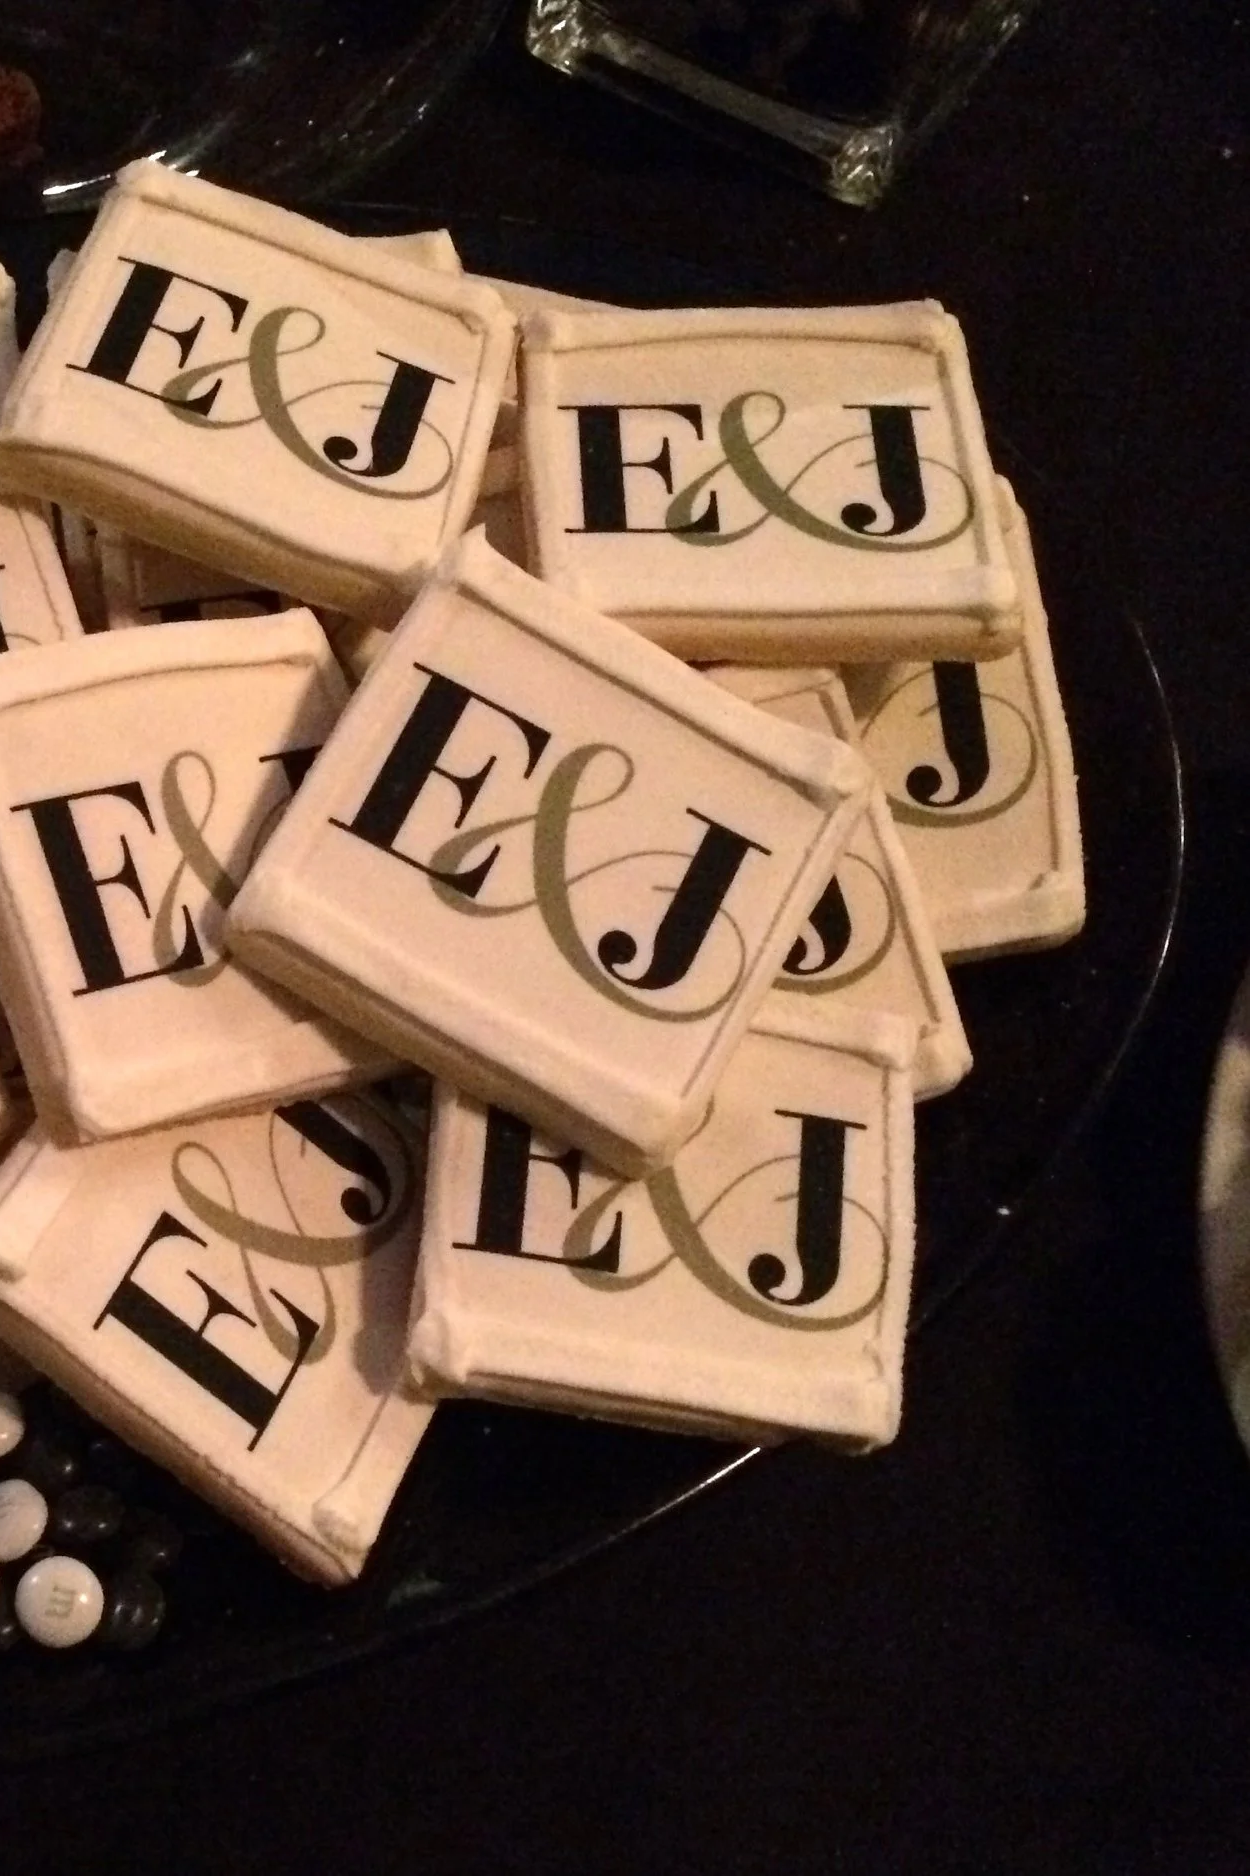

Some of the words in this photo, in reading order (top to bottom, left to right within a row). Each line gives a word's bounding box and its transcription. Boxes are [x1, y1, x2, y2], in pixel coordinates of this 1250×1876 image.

[66, 256, 456, 500] E&J
[558, 389, 975, 553] E&J
[329, 661, 771, 1024] E&J
